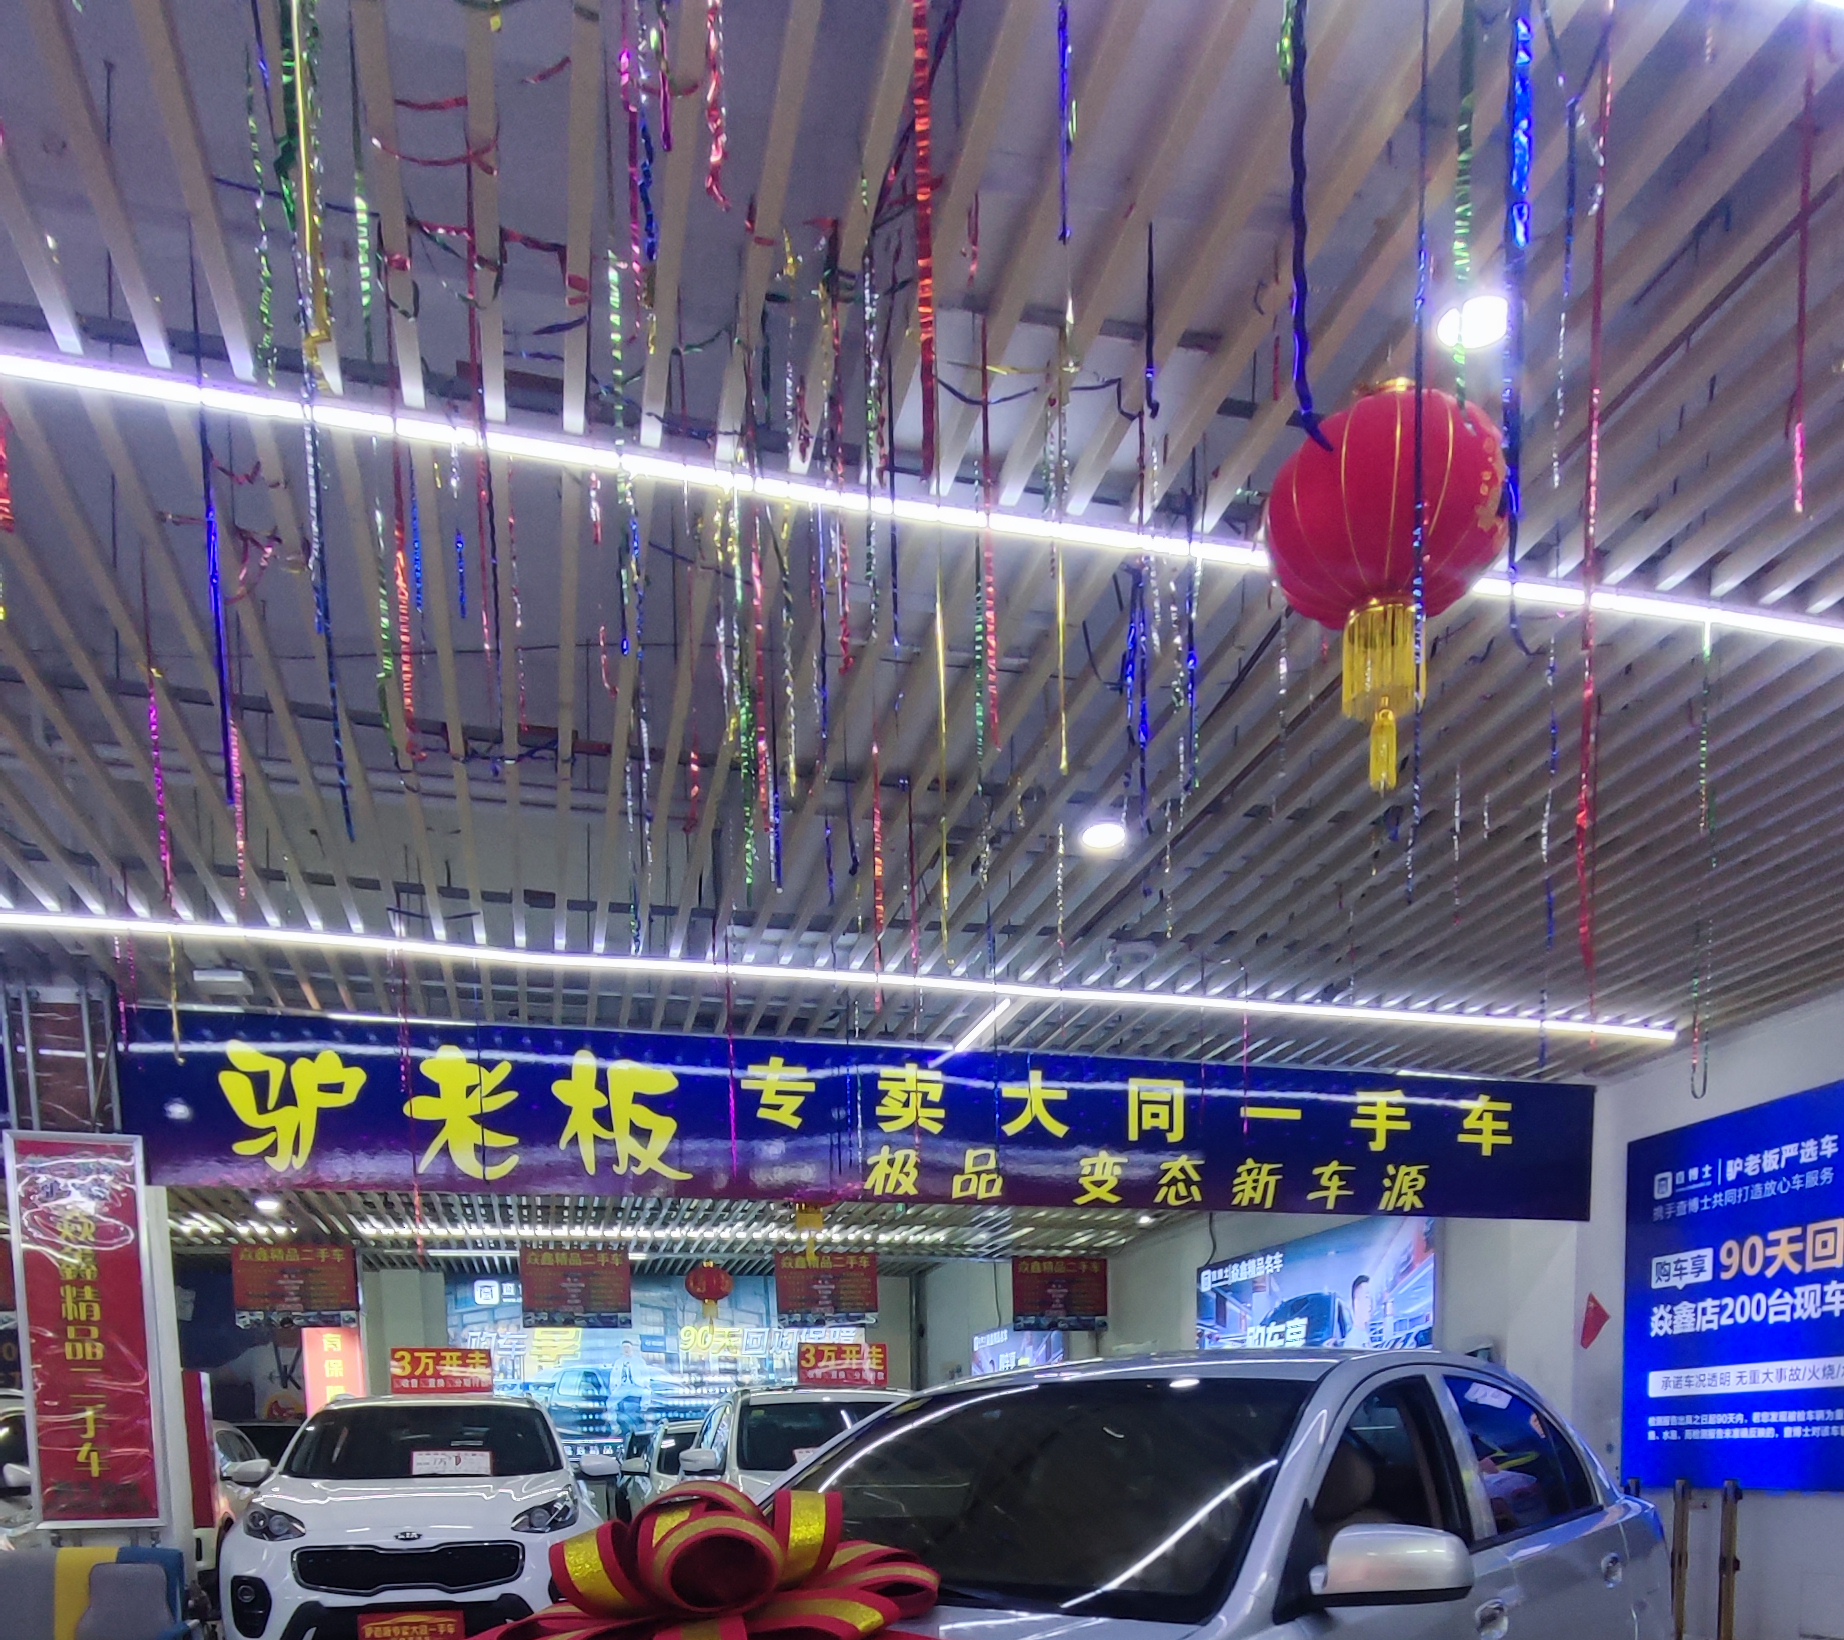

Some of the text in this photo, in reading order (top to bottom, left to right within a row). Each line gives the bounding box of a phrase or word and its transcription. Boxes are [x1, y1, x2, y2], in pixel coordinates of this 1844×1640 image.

[218, 1040, 1513, 1180] 驴老板 专卖大同一手车
[862, 1144, 1430, 1212] 极品 变态新车源
[1726, 1134, 1839, 1182] 驴老板严选车
[1652, 1166, 1835, 1222] 携手查博士共同打造放心车服务
[1655, 1254, 1708, 1284] 购车享
[1719, 1217, 1844, 1281] 90天回
[1649, 1279, 1844, 1338] 焱鑫店200台现车
[394, 1350, 489, 1377] 3万开走
[800, 1344, 884, 1370] 3万开走
[1660, 1371, 1732, 1391] 承诺车况透明
